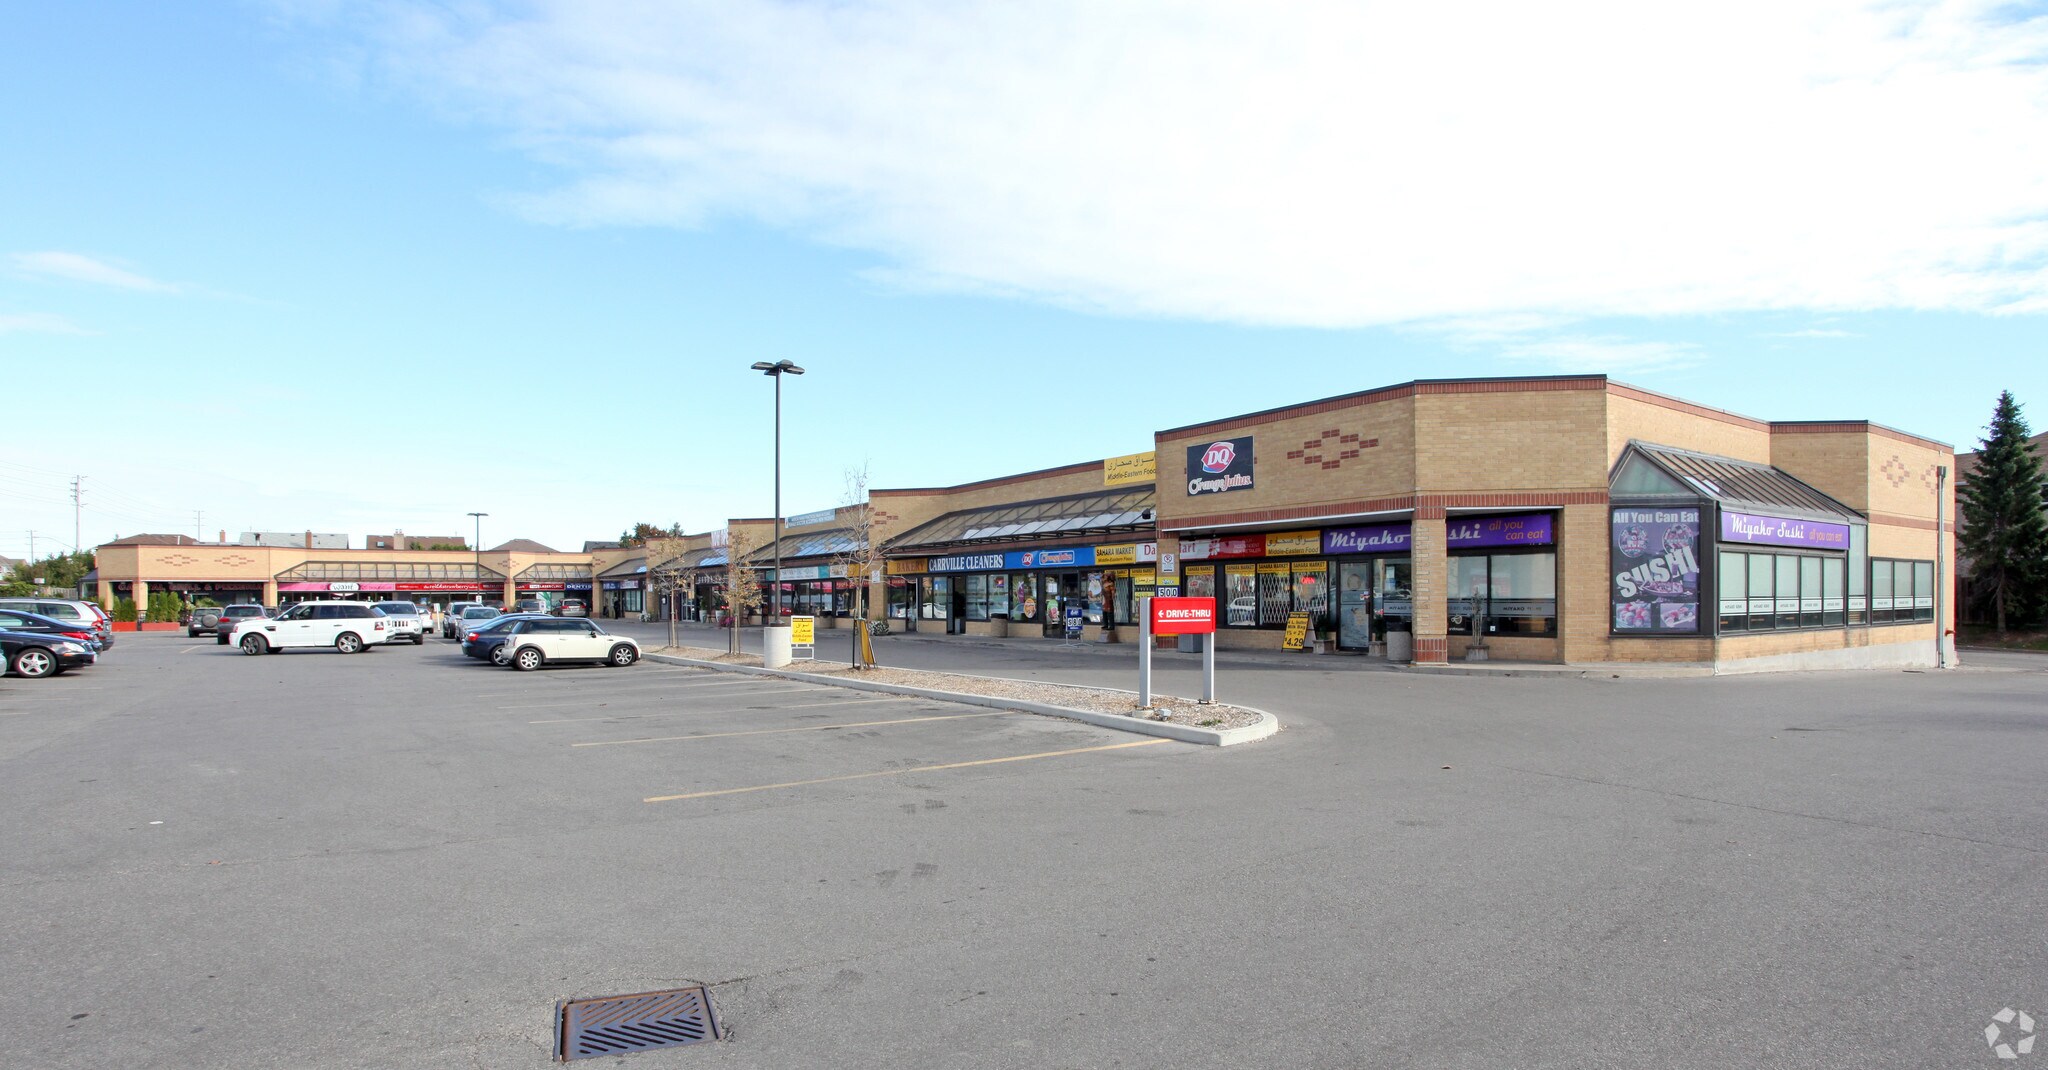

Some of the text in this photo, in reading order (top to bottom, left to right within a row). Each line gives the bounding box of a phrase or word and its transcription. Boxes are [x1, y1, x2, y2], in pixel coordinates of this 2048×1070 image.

[1207, 448, 1230, 466] DQ
[1613, 511, 1699, 523] All You Can Eat
[1489, 520, 1524, 532] all you
[1731, 514, 1775, 540] Miyako
[1777, 522, 1804, 539] Sushi
[1329, 523, 1481, 551] Miyako shi
[1505, 530, 1545, 540] can eat
[1096, 546, 1134, 556] SAHARA MARKET
[1144, 545, 1156, 556] Da
[1268, 547, 1304, 555] Middle-Eastern
[896, 561, 925, 573] BAKERY
[928, 554, 1004, 571] CARRVILLE CLEANERS
[1615, 545, 1699, 598] SUSHI
[1166, 609, 1211, 618] DRIVE-THRU
